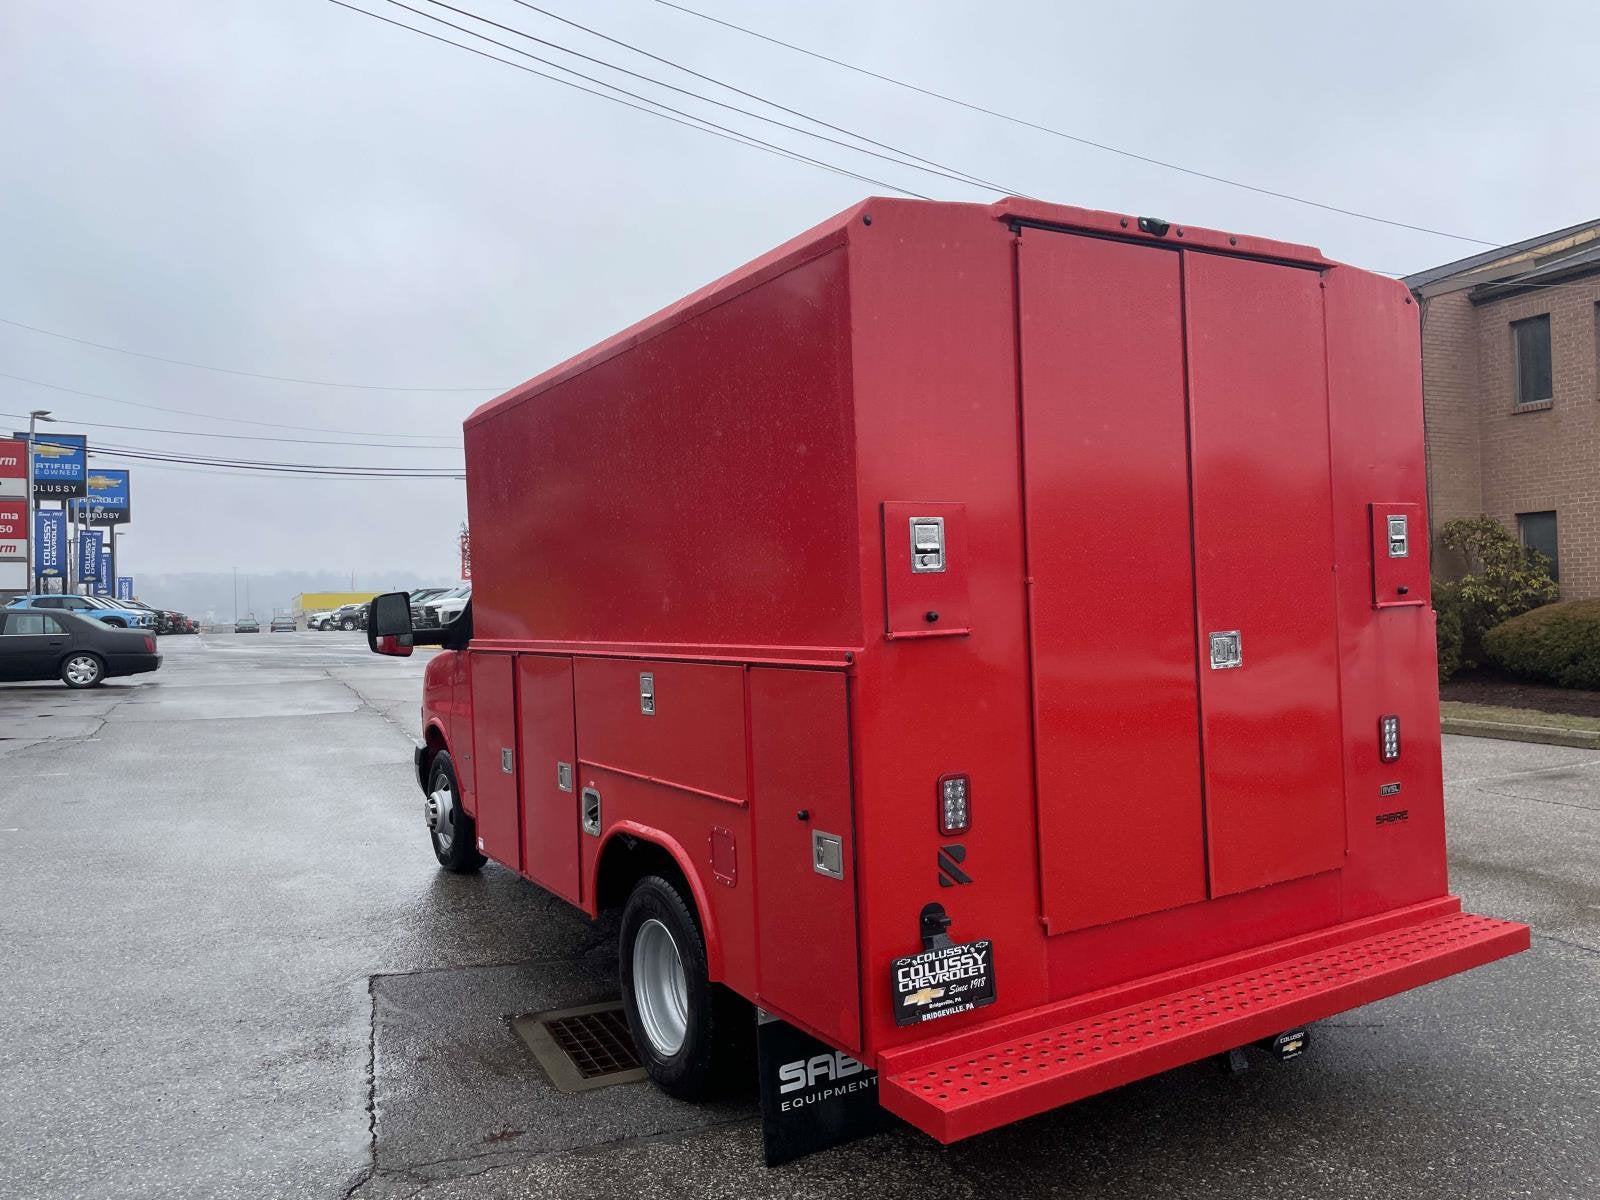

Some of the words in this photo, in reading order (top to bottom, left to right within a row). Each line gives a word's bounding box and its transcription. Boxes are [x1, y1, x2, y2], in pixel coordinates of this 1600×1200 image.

[33, 484, 77, 493] OLUSSY
[897, 950, 987, 982] COLUSSY
[916, 944, 970, 964] COLUSSY
[898, 963, 987, 993] CHEVROLET
[948, 983, 969, 995] Since
[970, 976, 987, 990] 1918
[965, 1002, 975, 1011] PA
[779, 1050, 866, 1095] SAB
[780, 1075, 879, 1112] EQUIPMENT
